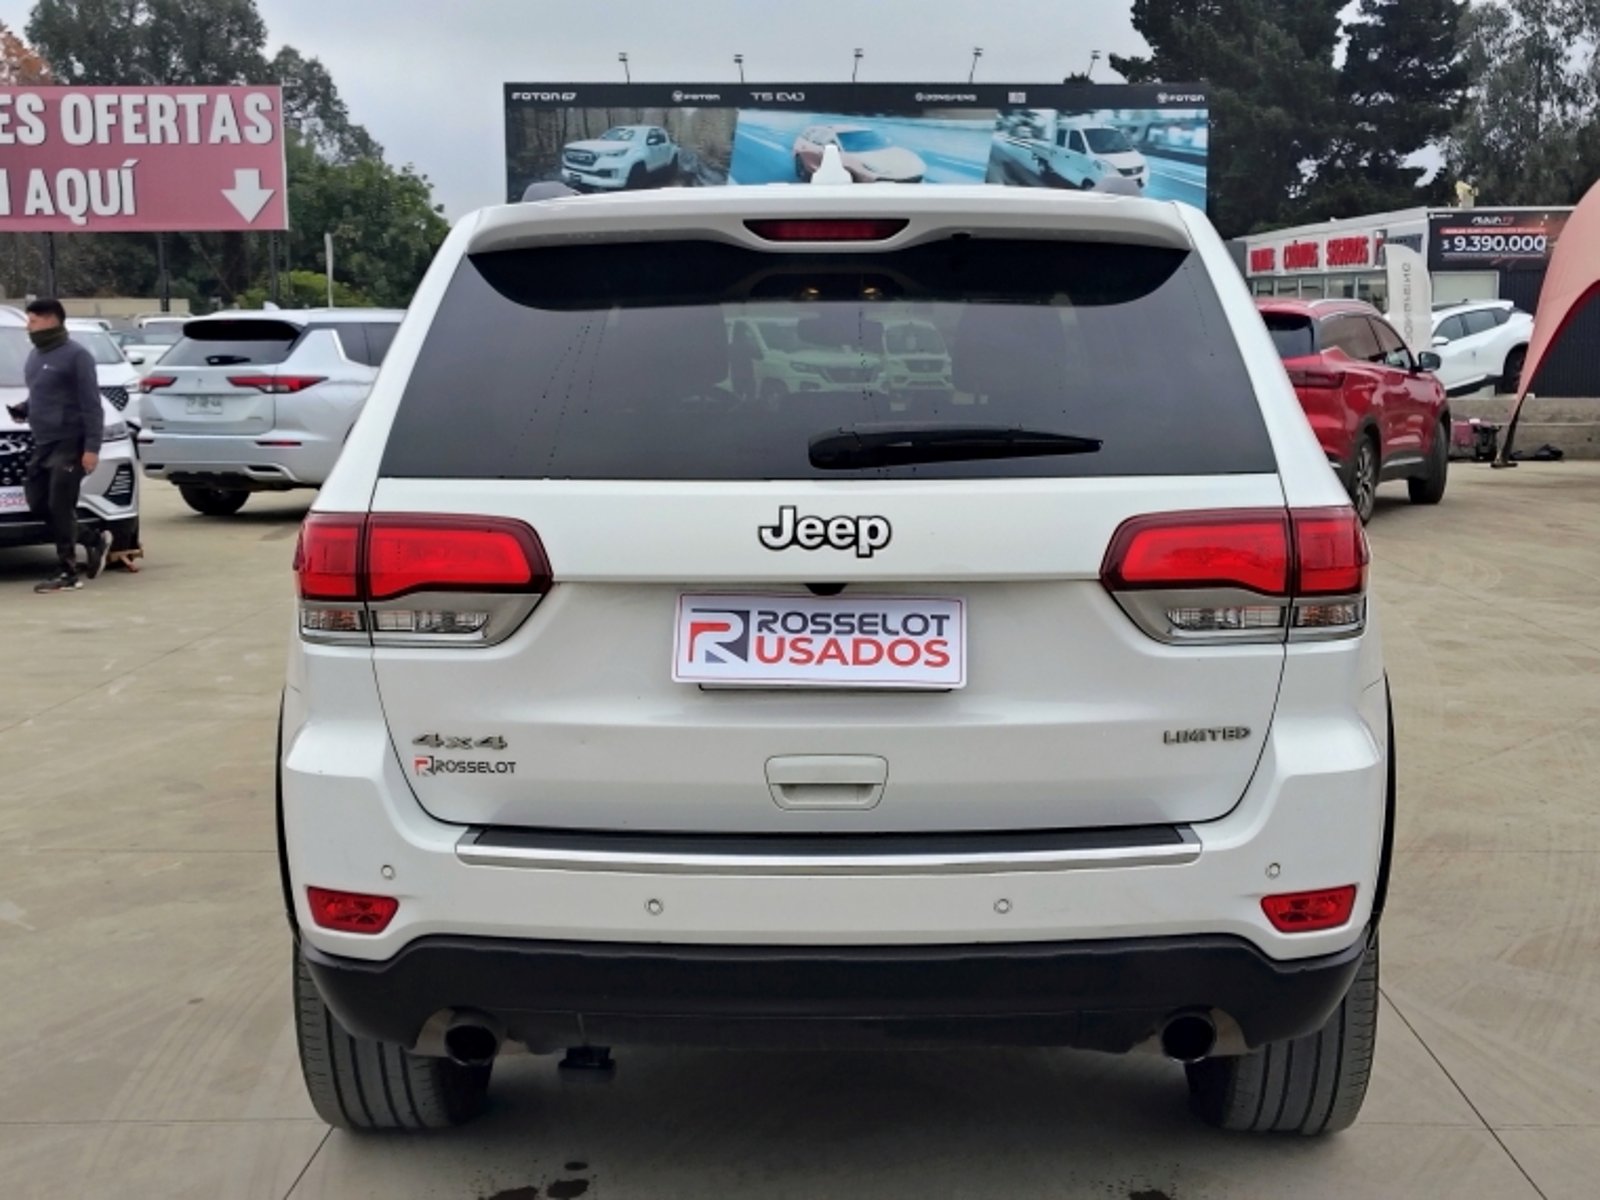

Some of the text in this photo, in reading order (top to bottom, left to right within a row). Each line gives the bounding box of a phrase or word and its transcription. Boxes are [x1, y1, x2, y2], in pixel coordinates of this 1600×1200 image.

[60, 92, 273, 145] OFERTAS
[24, 158, 139, 226] AQUÍ
[1453, 235, 1547, 252] 9.390.000
[758, 505, 892, 558] Jeep
[757, 610, 951, 637] ROSSELOT
[755, 636, 951, 668] USADOS
[1163, 725, 1252, 745] LIMITED
[434, 759, 516, 774] ROSSELOT
